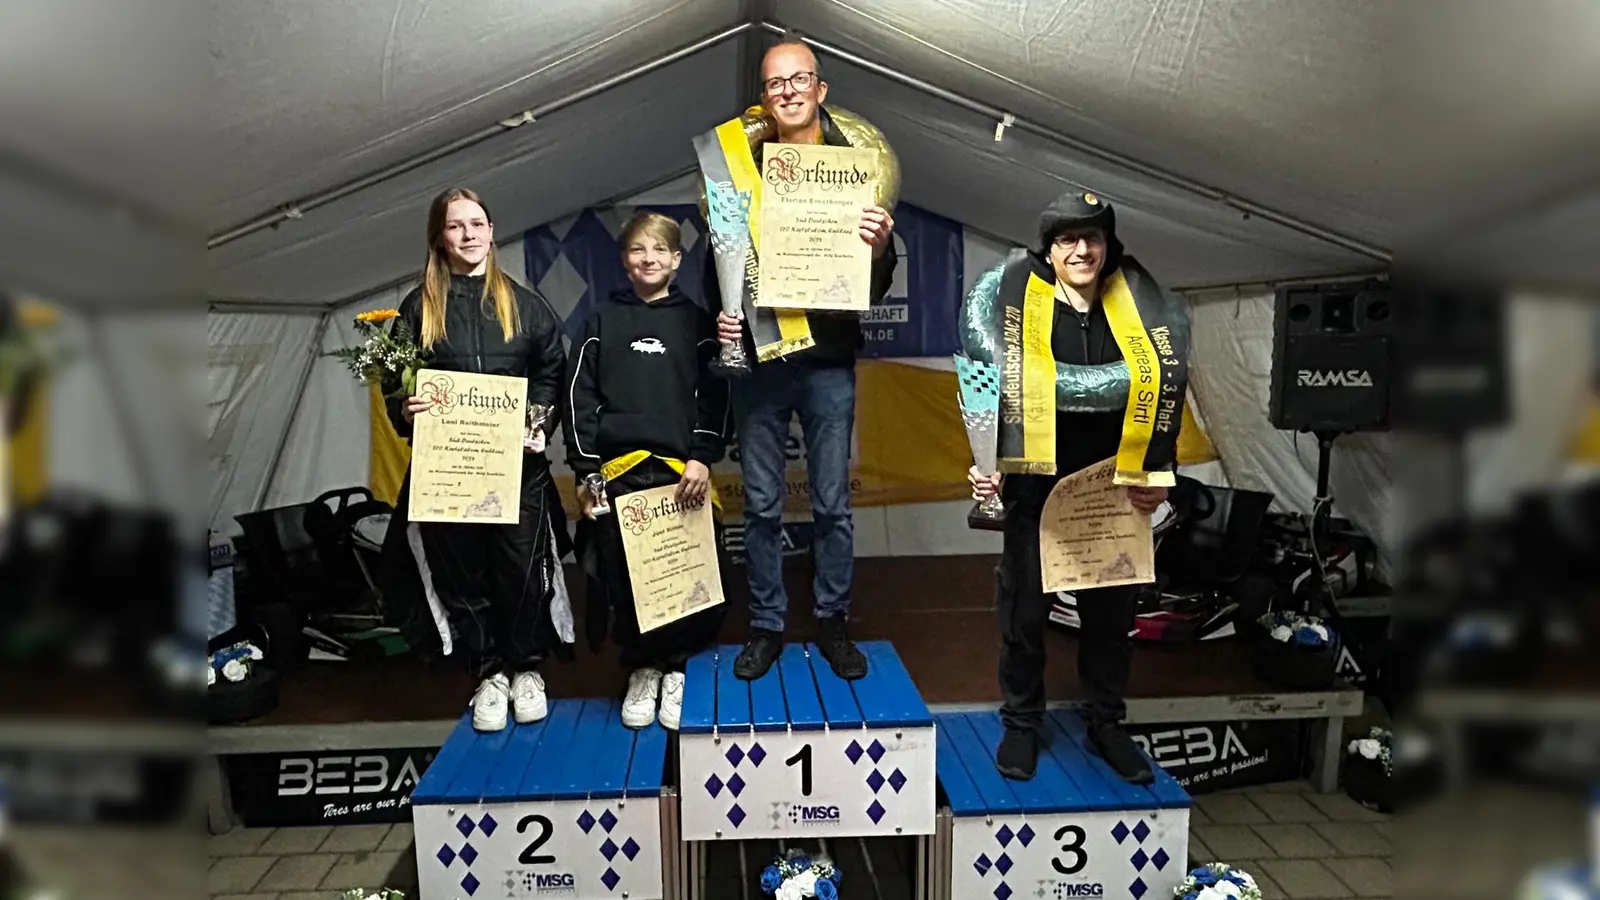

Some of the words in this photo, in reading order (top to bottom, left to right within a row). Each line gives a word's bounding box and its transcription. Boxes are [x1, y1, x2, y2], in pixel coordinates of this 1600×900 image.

[766, 147, 868, 196] Urkunde
[781, 196, 808, 204] Florian
[1005, 305, 1021, 318] 270
[863, 329, 895, 341] N.DE
[1149, 325, 1174, 356] Klasse
[1124, 335, 1152, 384] Andreas
[1162, 358, 1179, 366] 3
[1162, 383, 1179, 396] 3.
[1297, 369, 1374, 387] RAMSA
[420, 373, 519, 417] Urkunde
[1133, 389, 1155, 424] Sirtl
[1156, 399, 1176, 433] Platz
[277, 754, 421, 796] BEBA
[785, 744, 812, 797] 1
[1193, 771, 1210, 783] are
[1212, 766, 1228, 777] our
[1231, 750, 1269, 775] passion!
[352, 803, 373, 814] are
[376, 798, 397, 809] our
[802, 806, 840, 820] MSG
[516, 814, 556, 864] 2
[1051, 825, 1088, 875] 3
[536, 873, 574, 887] MSG
[1066, 883, 1104, 896] MSG
